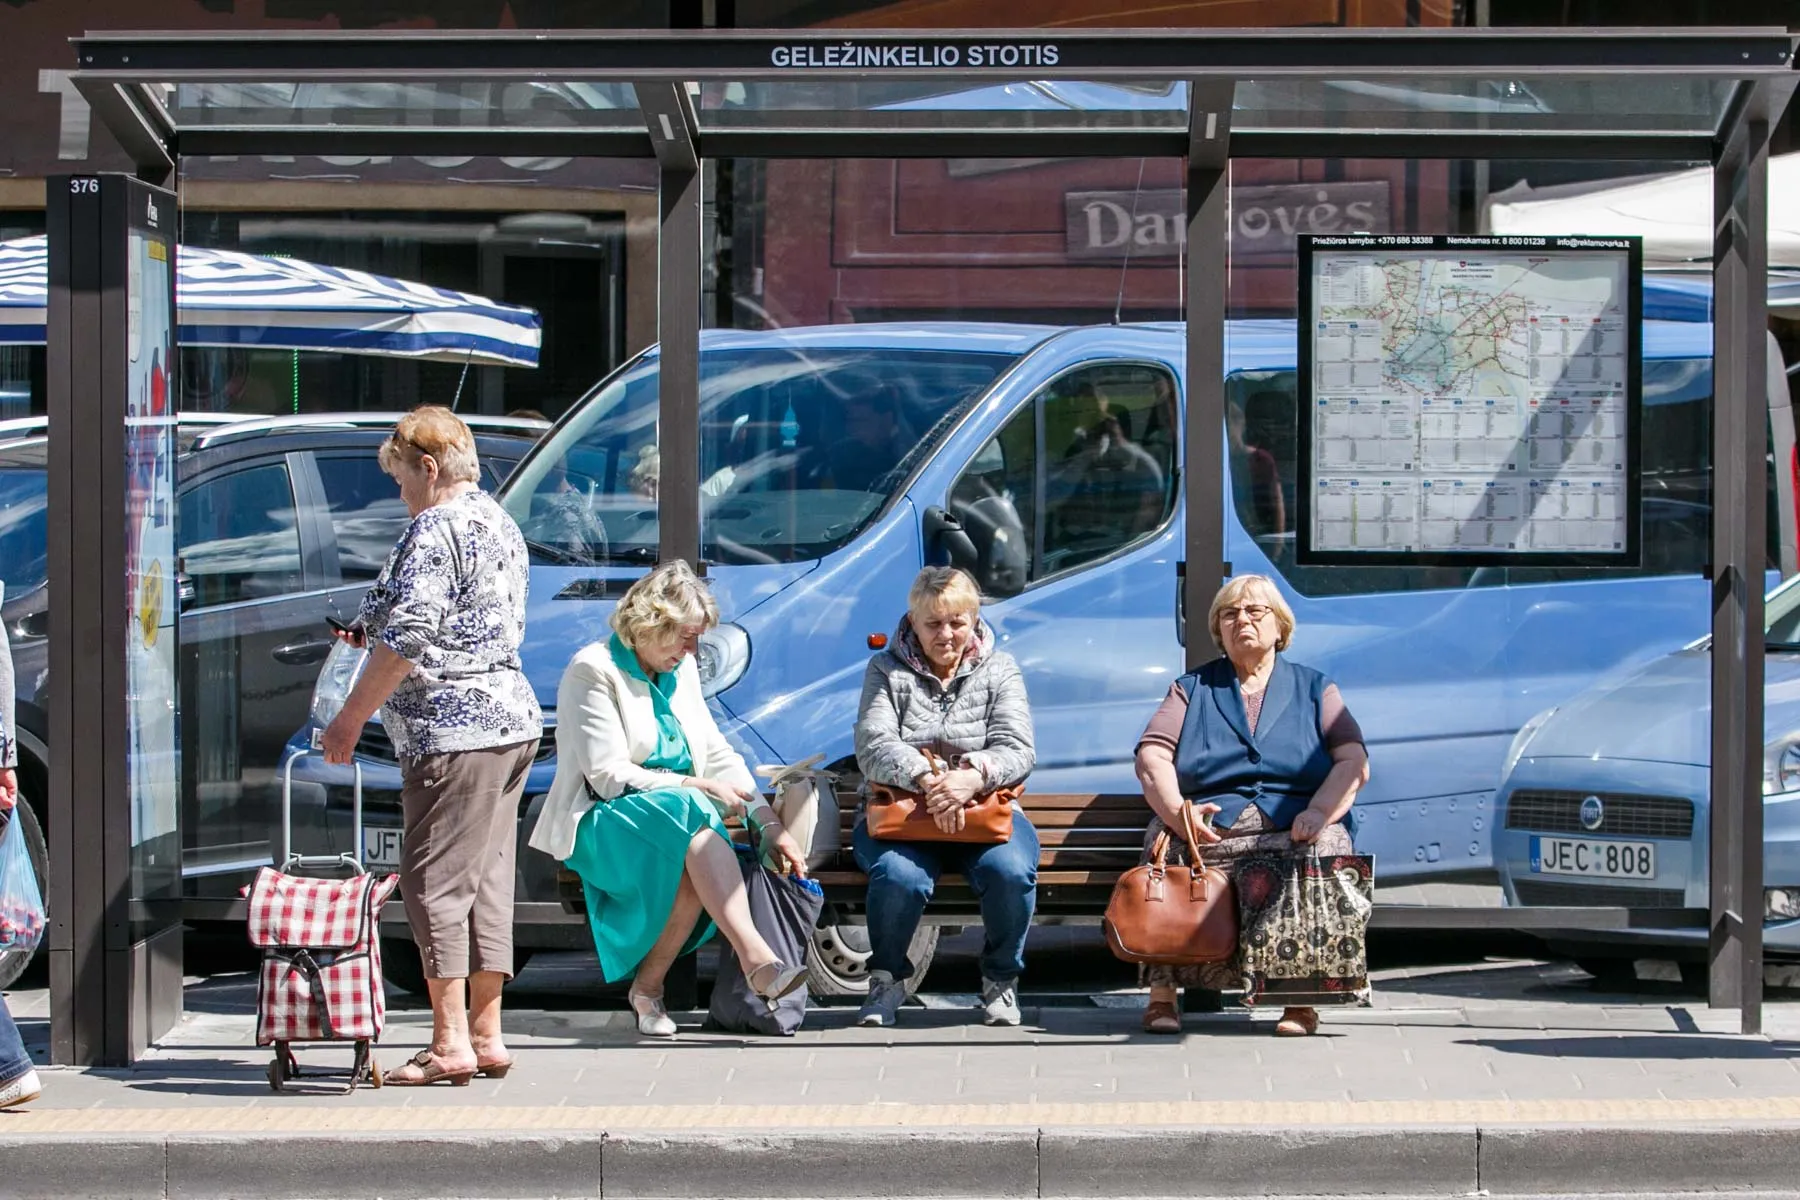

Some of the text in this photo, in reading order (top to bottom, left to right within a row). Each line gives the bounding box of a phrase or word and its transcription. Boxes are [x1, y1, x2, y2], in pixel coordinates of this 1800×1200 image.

[771, 42, 1060, 67] GELEŽINKELIO STOTIS
[70, 179, 99, 193] 376
[1447, 237, 1490, 245] Nemokamas
[1508, 237, 1523, 245] 800
[1544, 841, 1650, 874] JEC 808
